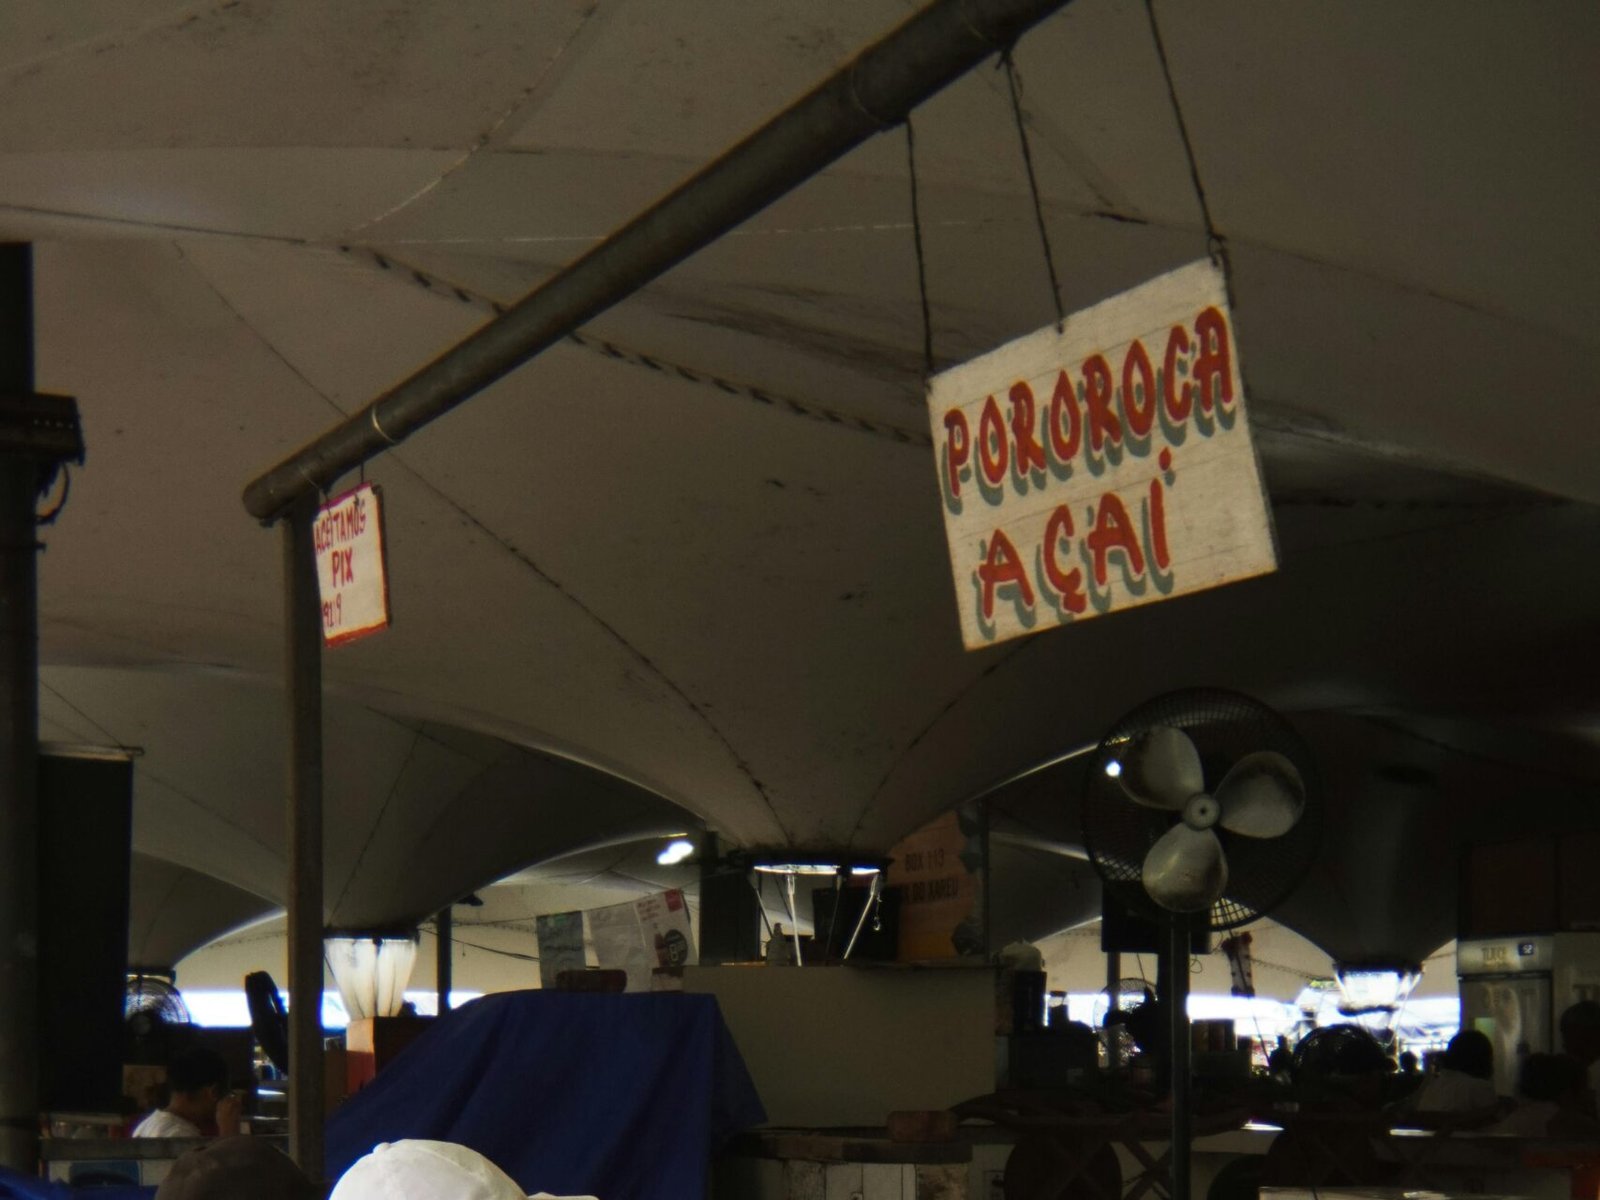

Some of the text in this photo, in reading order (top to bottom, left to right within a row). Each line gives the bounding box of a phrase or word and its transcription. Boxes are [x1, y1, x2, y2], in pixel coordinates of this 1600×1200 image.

[943, 306, 1235, 503] POROROCA
[332, 547, 354, 588] PIX
[905, 853, 924, 872] BOX
